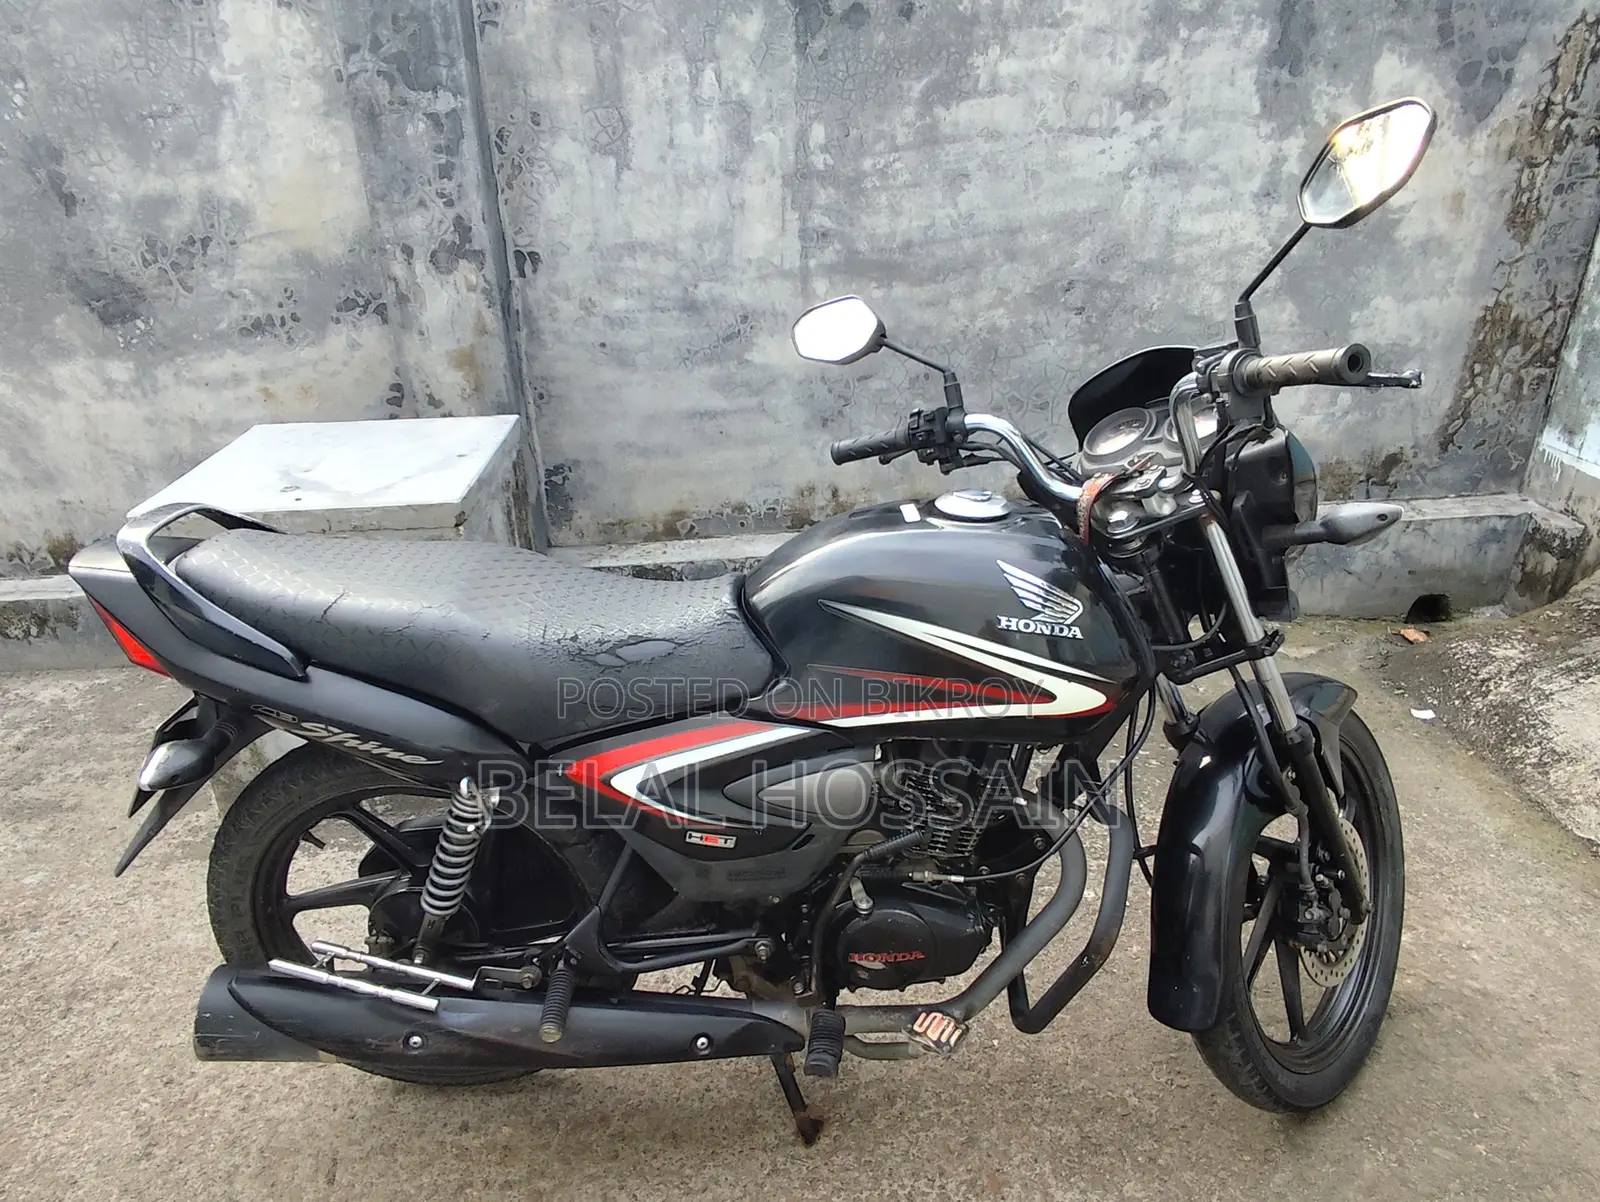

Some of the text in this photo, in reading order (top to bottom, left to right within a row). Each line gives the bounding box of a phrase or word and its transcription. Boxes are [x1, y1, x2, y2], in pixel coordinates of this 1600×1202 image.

[996, 614, 1084, 640] HONDA
[687, 832, 735, 847] HET
[848, 951, 925, 963] HONDA
